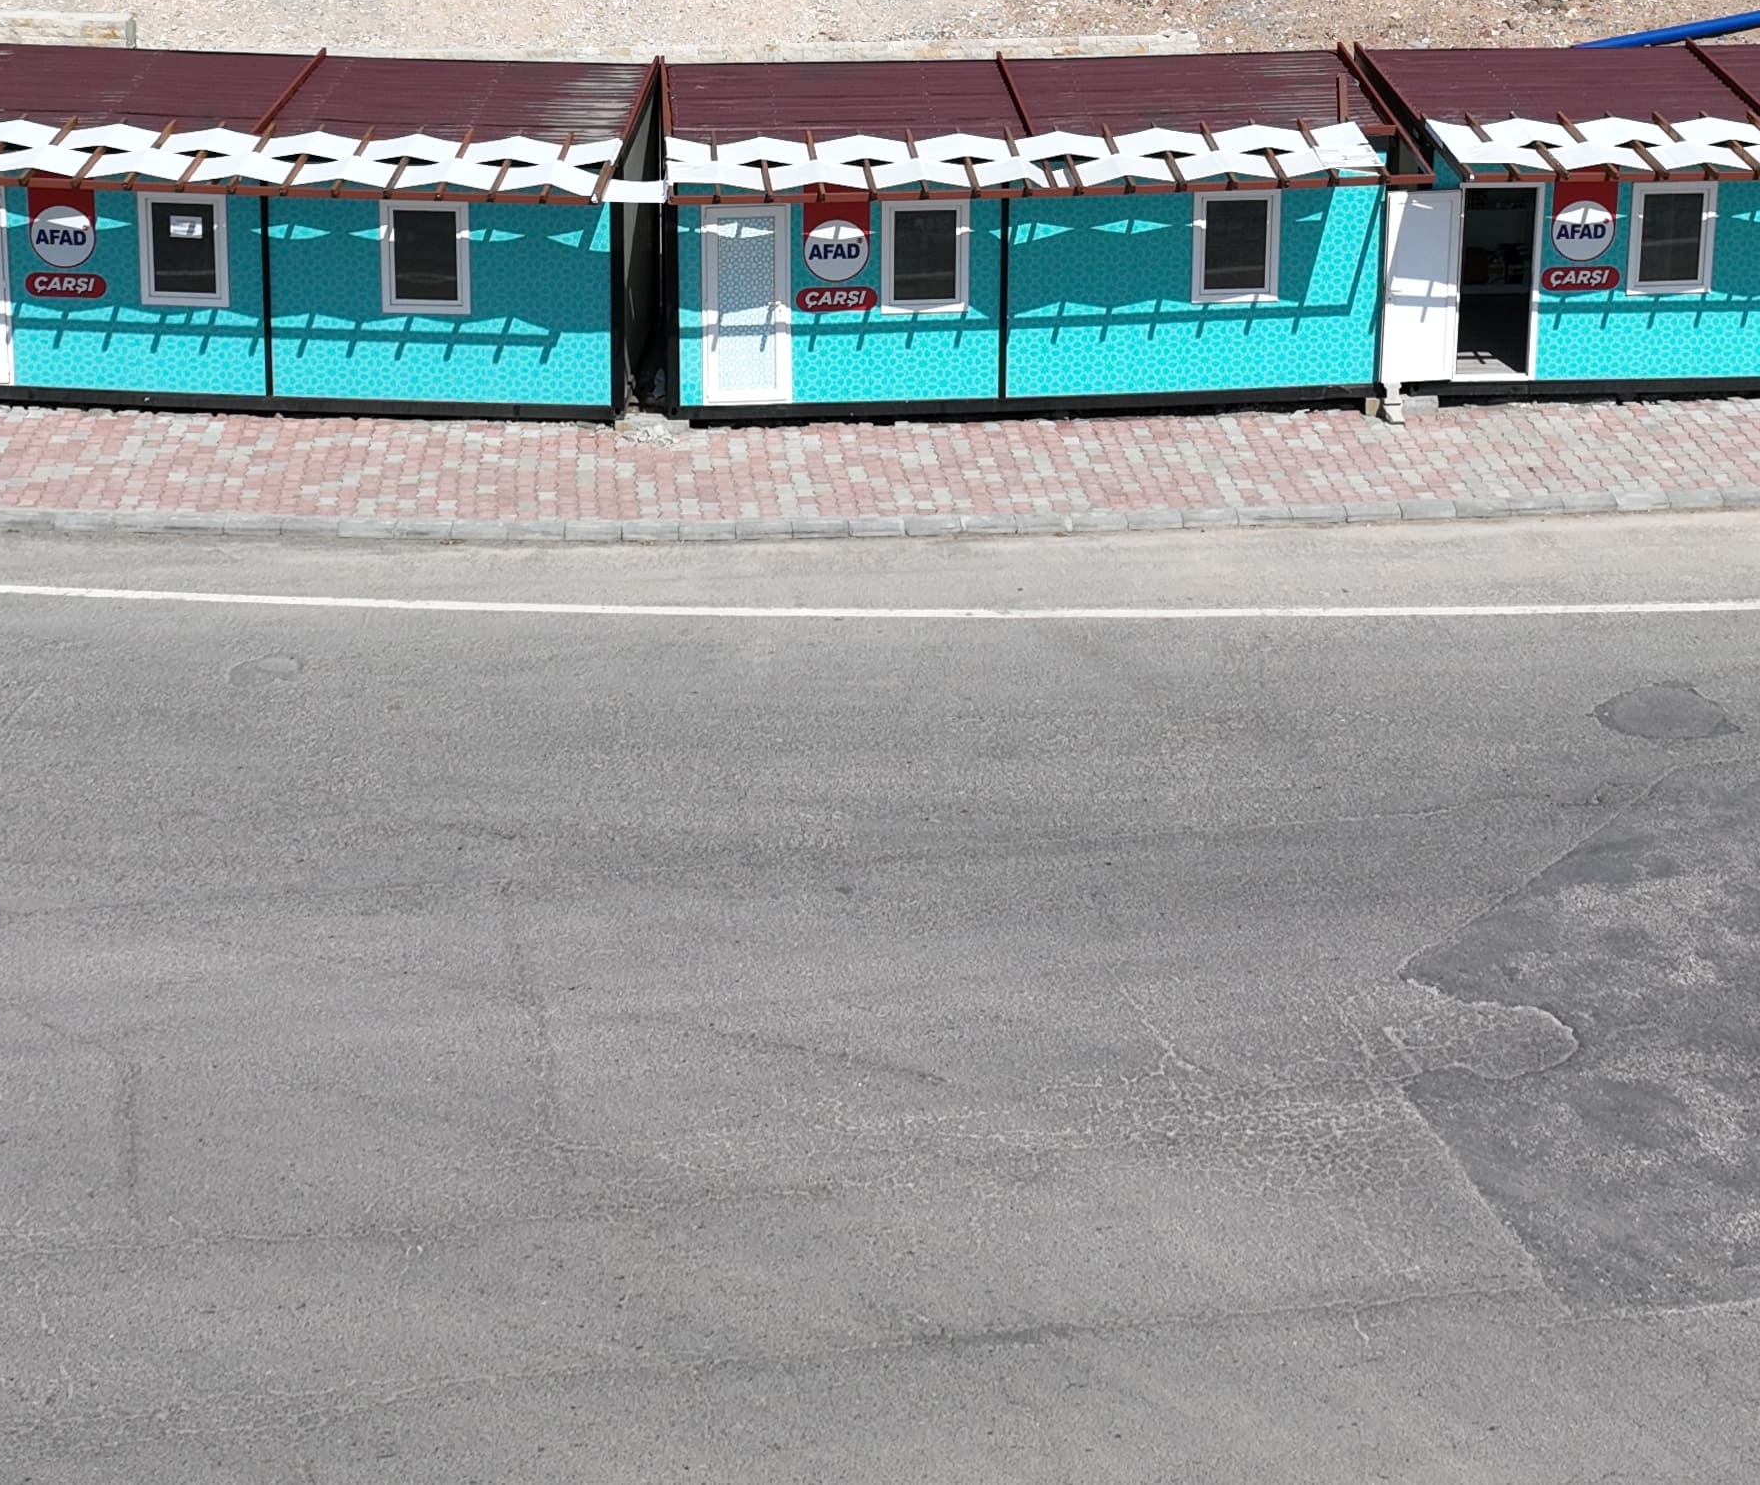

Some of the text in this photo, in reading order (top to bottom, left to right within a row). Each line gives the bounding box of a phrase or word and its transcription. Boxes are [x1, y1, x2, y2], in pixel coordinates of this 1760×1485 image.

[35, 229, 87, 246] AFAD
[1556, 224, 1606, 240] AFAD
[808, 243, 860, 260] AFAD
[34, 276, 95, 294] ÇARŞI
[1550, 269, 1610, 287] ÇARŞI
[804, 290, 867, 308] ÇARŞI
